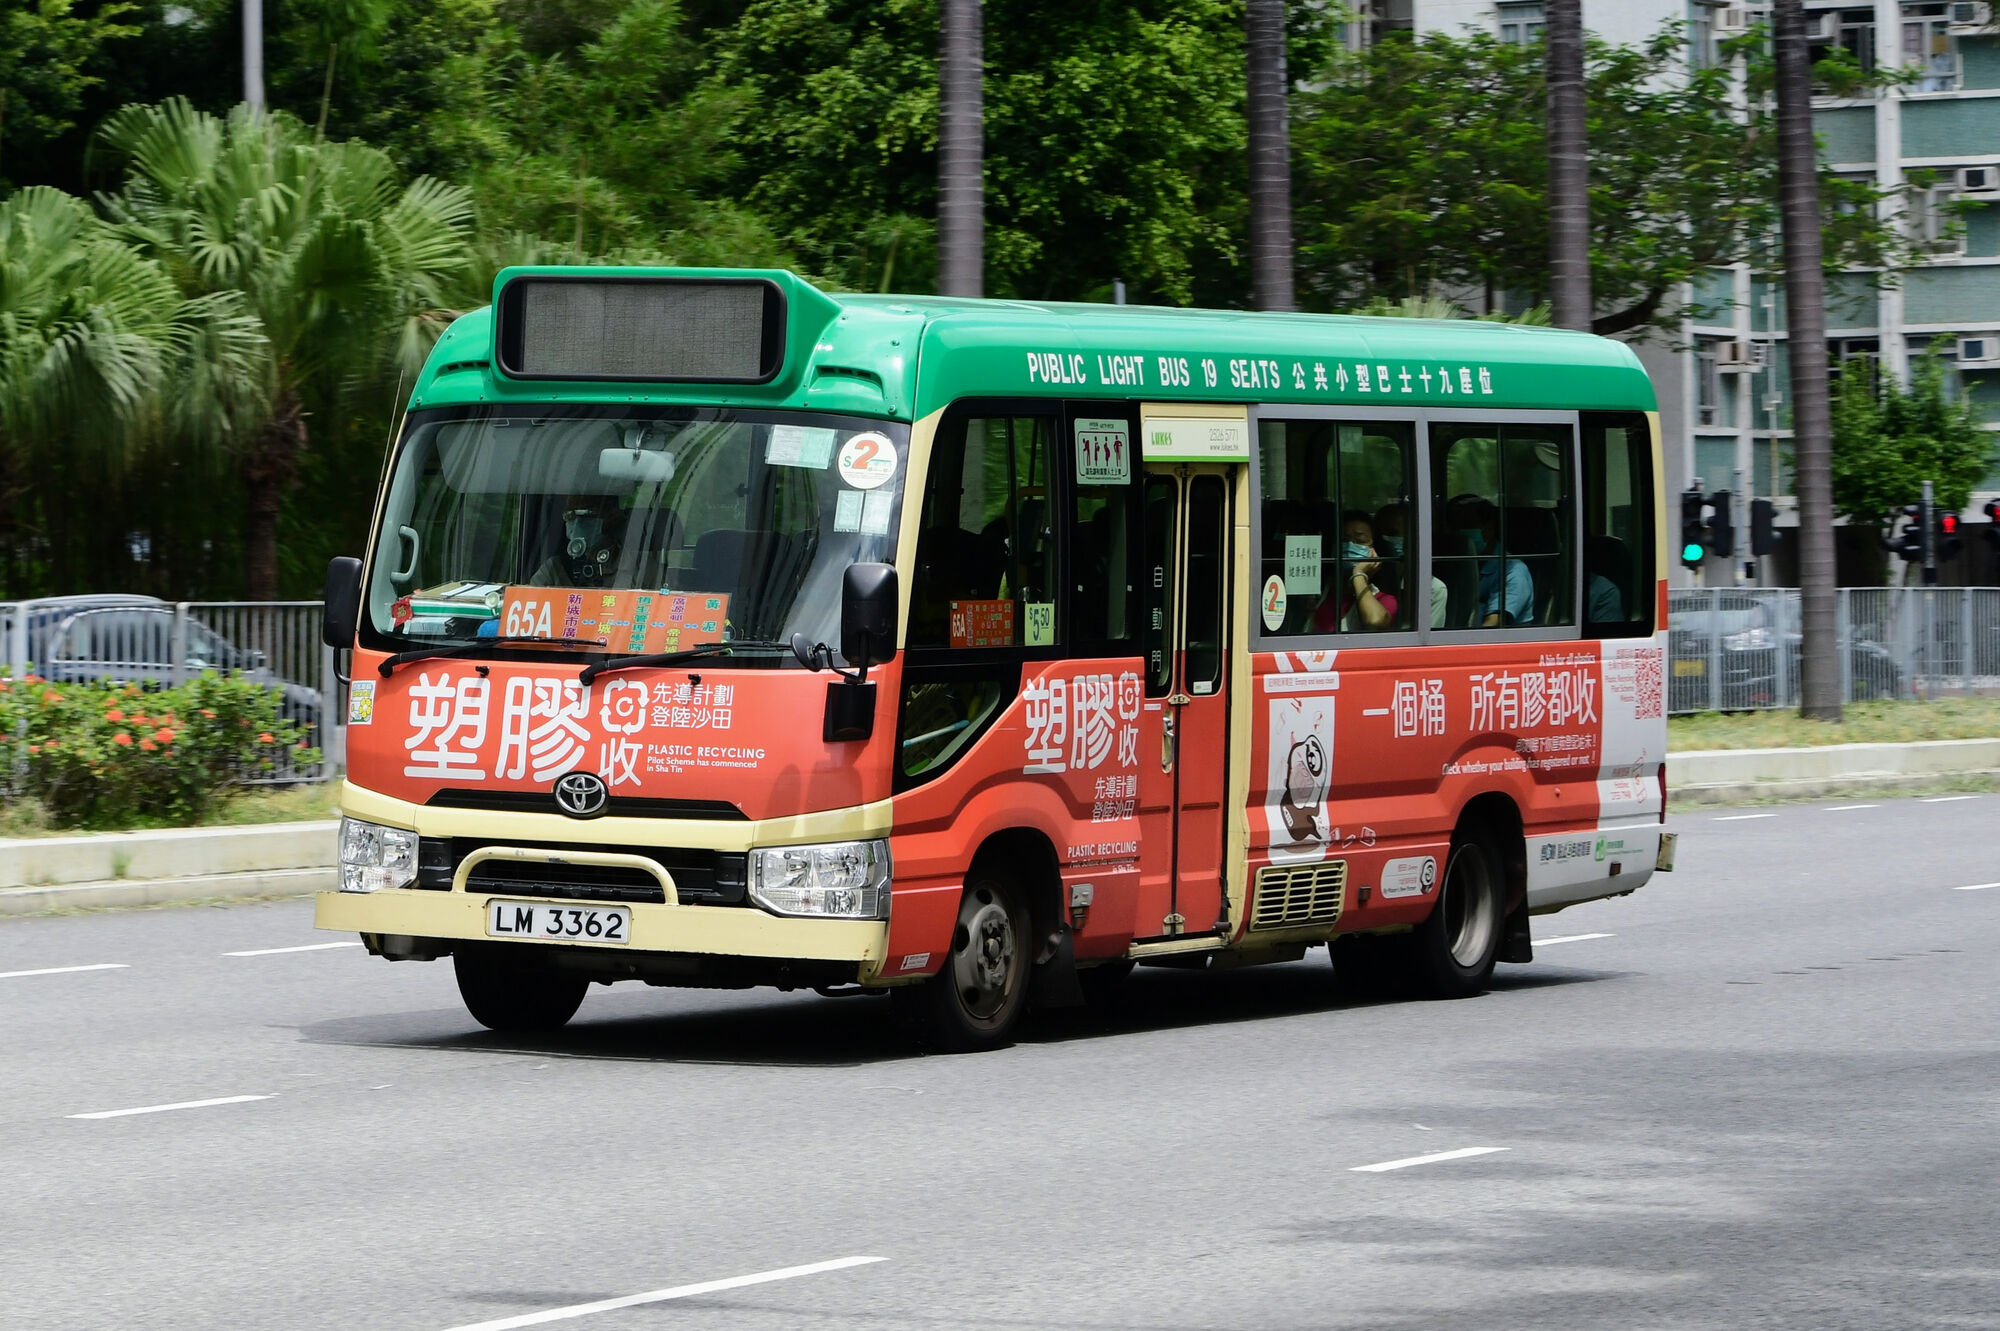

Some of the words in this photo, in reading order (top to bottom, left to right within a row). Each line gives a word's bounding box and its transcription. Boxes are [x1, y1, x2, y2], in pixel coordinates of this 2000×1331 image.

[1027, 352, 1086, 384] PUBLIC
[1098, 355, 1145, 385] LIGHT
[1158, 357, 1190, 387] BUS
[1201, 359, 1217, 387] 19
[1230, 359, 1281, 389] SEATS
[1292, 362, 1494, 394] 公共小型巴士十九座位
[844, 440, 879, 469] $2
[506, 600, 552, 638] 65A
[597, 595, 617, 635] 第一城
[952, 613, 966, 638] 65A
[652, 682, 735, 706] 先導計劃
[1362, 678, 1446, 738] 一個桶
[1469, 668, 1597, 731] 所有膠都收
[404, 672, 592, 783] 塑膠
[650, 706, 732, 729] 登陸沙田
[1022, 674, 1116, 775] 塑膠
[648, 744, 693, 756] PLASTIC
[697, 747, 765, 759] RECYCLING
[1118, 724, 1139, 768] 收
[598, 737, 643, 787] 收
[655, 765, 669, 773] Sha
[666, 757, 695, 766] Scheme
[697, 758, 709, 766] has
[711, 760, 757, 769] commenced
[1442, 761, 1461, 775] Check
[1462, 760, 1488, 774] whether
[1489, 762, 1503, 775] your
[1504, 757, 1527, 773] building
[1540, 754, 1570, 771] registered
[1094, 774, 1137, 799] 先導計劃
[1091, 800, 1135, 823] 登陸沙田
[1067, 844, 1095, 858] PLASTIC
[1098, 841, 1137, 855] RECYCLING
[496, 906, 534, 933] LM
[546, 909, 623, 939] 3362
